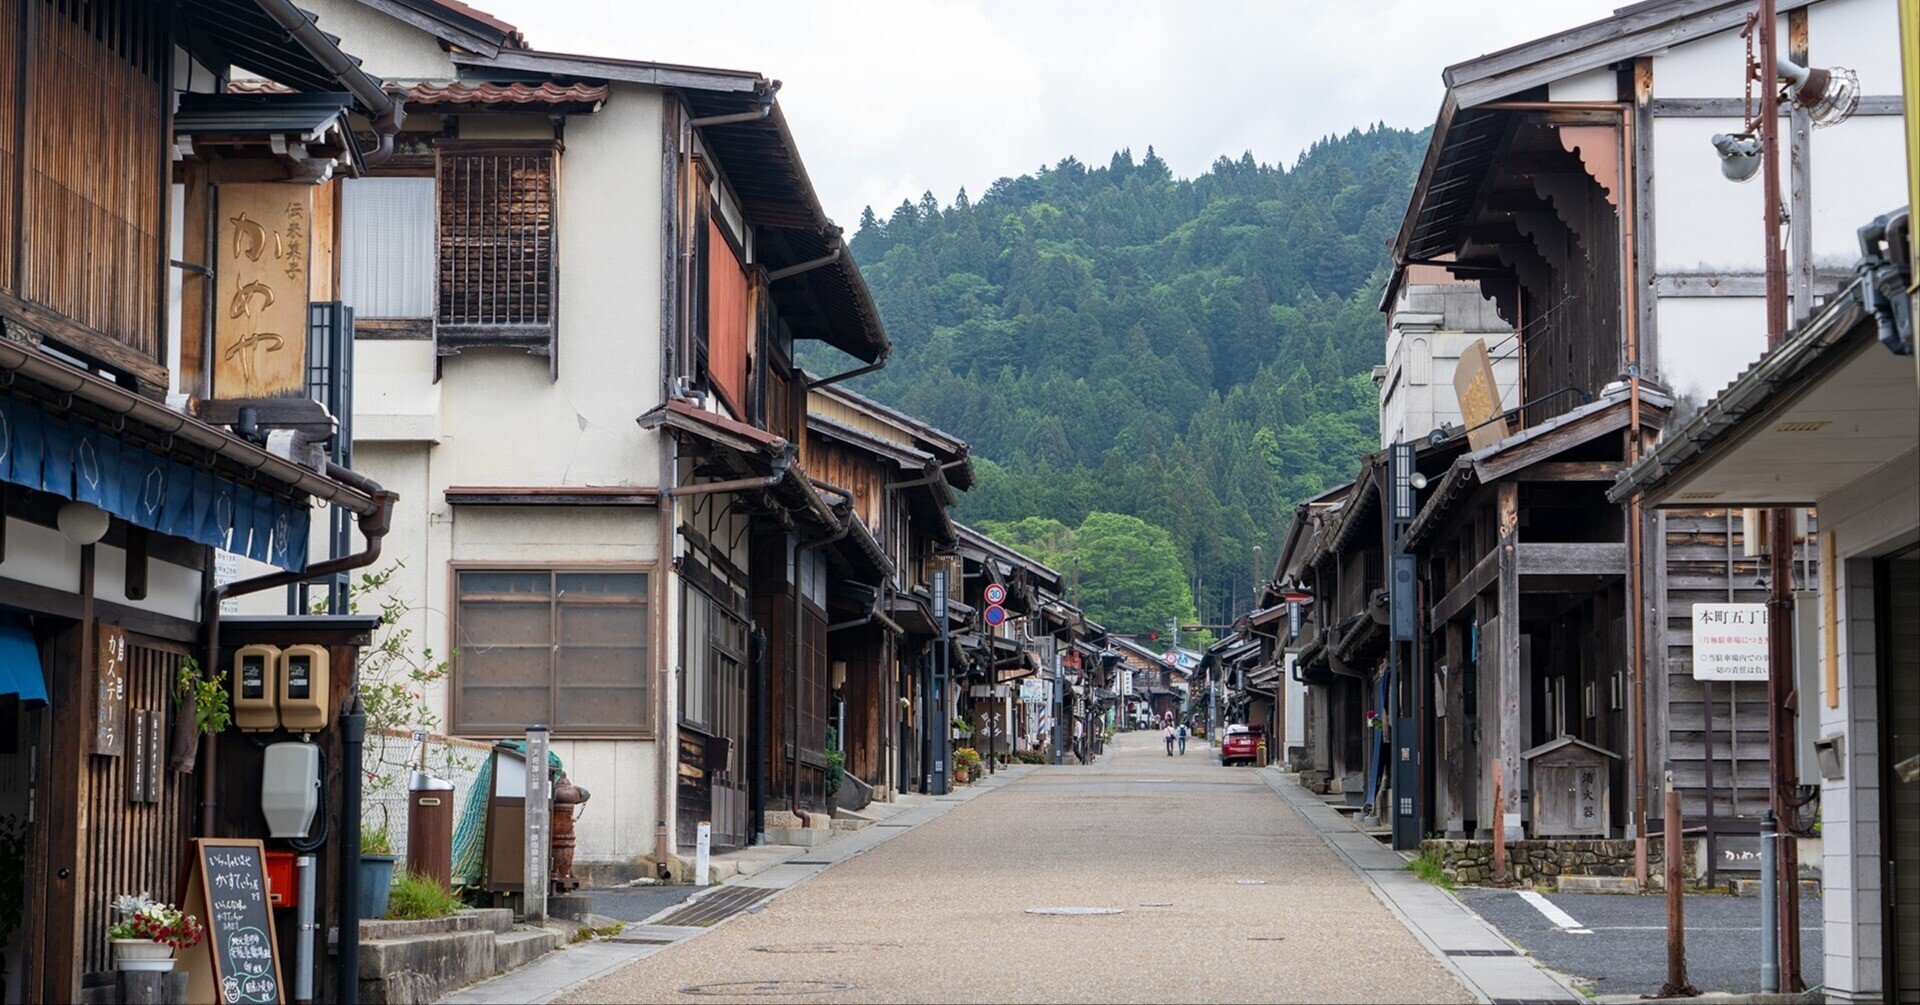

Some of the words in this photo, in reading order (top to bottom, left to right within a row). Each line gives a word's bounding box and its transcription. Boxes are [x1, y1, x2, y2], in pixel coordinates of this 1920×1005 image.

[224, 211, 285, 384] かめや
[989, 589, 1001, 600] 30
[106, 635, 116, 747] カステーラ
[1582, 771, 1595, 818] 消火器
